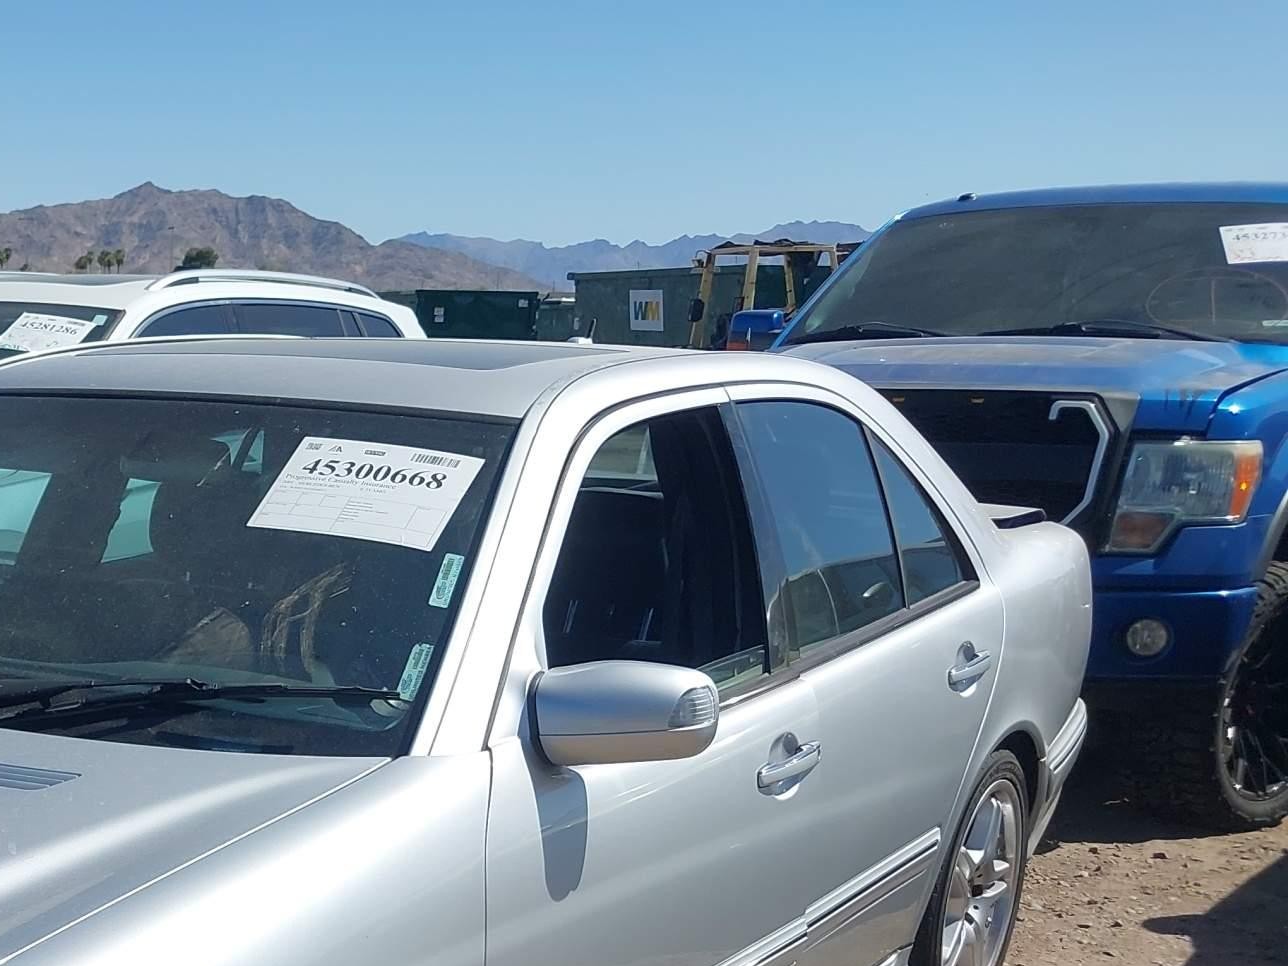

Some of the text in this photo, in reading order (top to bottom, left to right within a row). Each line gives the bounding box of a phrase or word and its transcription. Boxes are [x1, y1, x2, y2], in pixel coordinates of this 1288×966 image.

[633, 300, 661, 320] WM
[20, 319, 79, 336] 45281286
[285, 473, 327, 483] Progressive
[327, 477, 359, 486] Casualty
[360, 480, 398, 490] Insurance
[302, 458, 447, 490] 45300668
